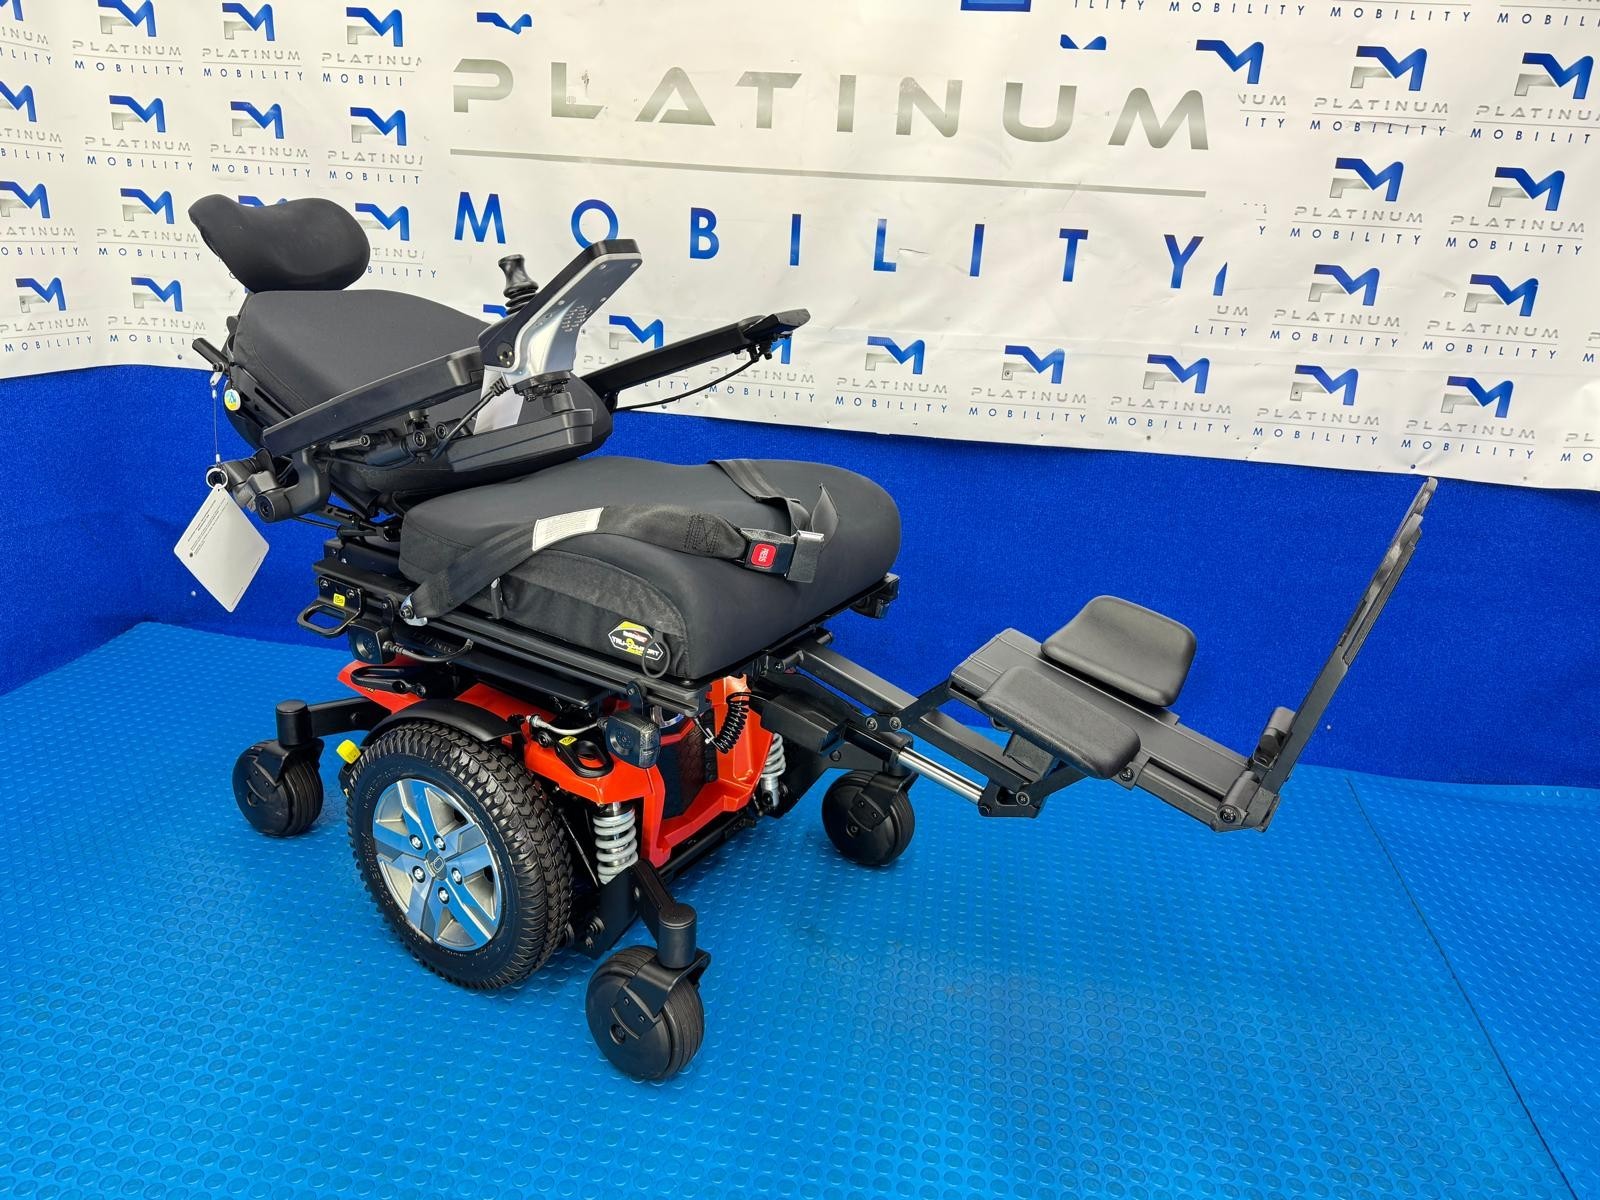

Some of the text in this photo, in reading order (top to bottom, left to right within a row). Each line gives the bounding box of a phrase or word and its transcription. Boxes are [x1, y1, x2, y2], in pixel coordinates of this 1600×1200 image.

[1168, 0, 1306, 16] MOBILITY
[1330, 6, 1472, 23] MOBILITY
[72, 39, 182, 57] PLATINUM
[202, 47, 301, 61] PLATINUM
[74, 60, 184, 76] MOBILITY
[203, 67, 304, 81] MOBILITY
[453, 58, 1209, 150] PLATINUM
[1313, 97, 1449, 114] PLATINUM
[0, 127, 62, 143] TINUM
[1309, 119, 1447, 137] MOBILITY
[1470, 128, 1592, 145] MOBILIT
[84, 136, 191, 152] PLATINUM
[210, 143, 309, 158] PLATINUM
[87, 155, 193, 171] MOBILITY
[211, 163, 311, 178] MOBILITY
[1293, 205, 1423, 224] PLATINUM
[0, 225, 76, 237] ATINUM
[1450, 214, 1585, 234] PLATINUM
[96, 228, 199, 244] PLATINUM
[454, 191, 1204, 289] MOBILITY
[1290, 227, 1422, 246] MOBILITY
[98, 247, 201, 261] MOBILITY
[1445, 236, 1583, 256] MOBILITY
[0, 317, 89, 334] PLATINUM
[107, 316, 207, 331] PLATINUM
[1273, 308, 1401, 328] PLATINUM
[1269, 329, 1399, 348] MOBILITY
[1426, 319, 1559, 340] PLATINUM
[4, 333, 93, 353] MOBILITY
[1422, 340, 1557, 361] MOBILITY
[709, 366, 816, 384] PLATINUM
[708, 385, 815, 403] MOBILITY
[836, 376, 948, 394] PLATINUM
[970, 386, 1087, 404] PLATINUM
[835, 395, 948, 414] MOBILITY
[1110, 395, 1232, 415] PLATINUM
[968, 406, 1086, 424] MOBILITY
[1256, 407, 1380, 426] PLATINUM
[1107, 416, 1230, 434] MOBILITY
[1406, 418, 1536, 440] PLATINUM
[1253, 426, 1378, 446] MOBILITY
[1401, 438, 1534, 460] MOBILITY
